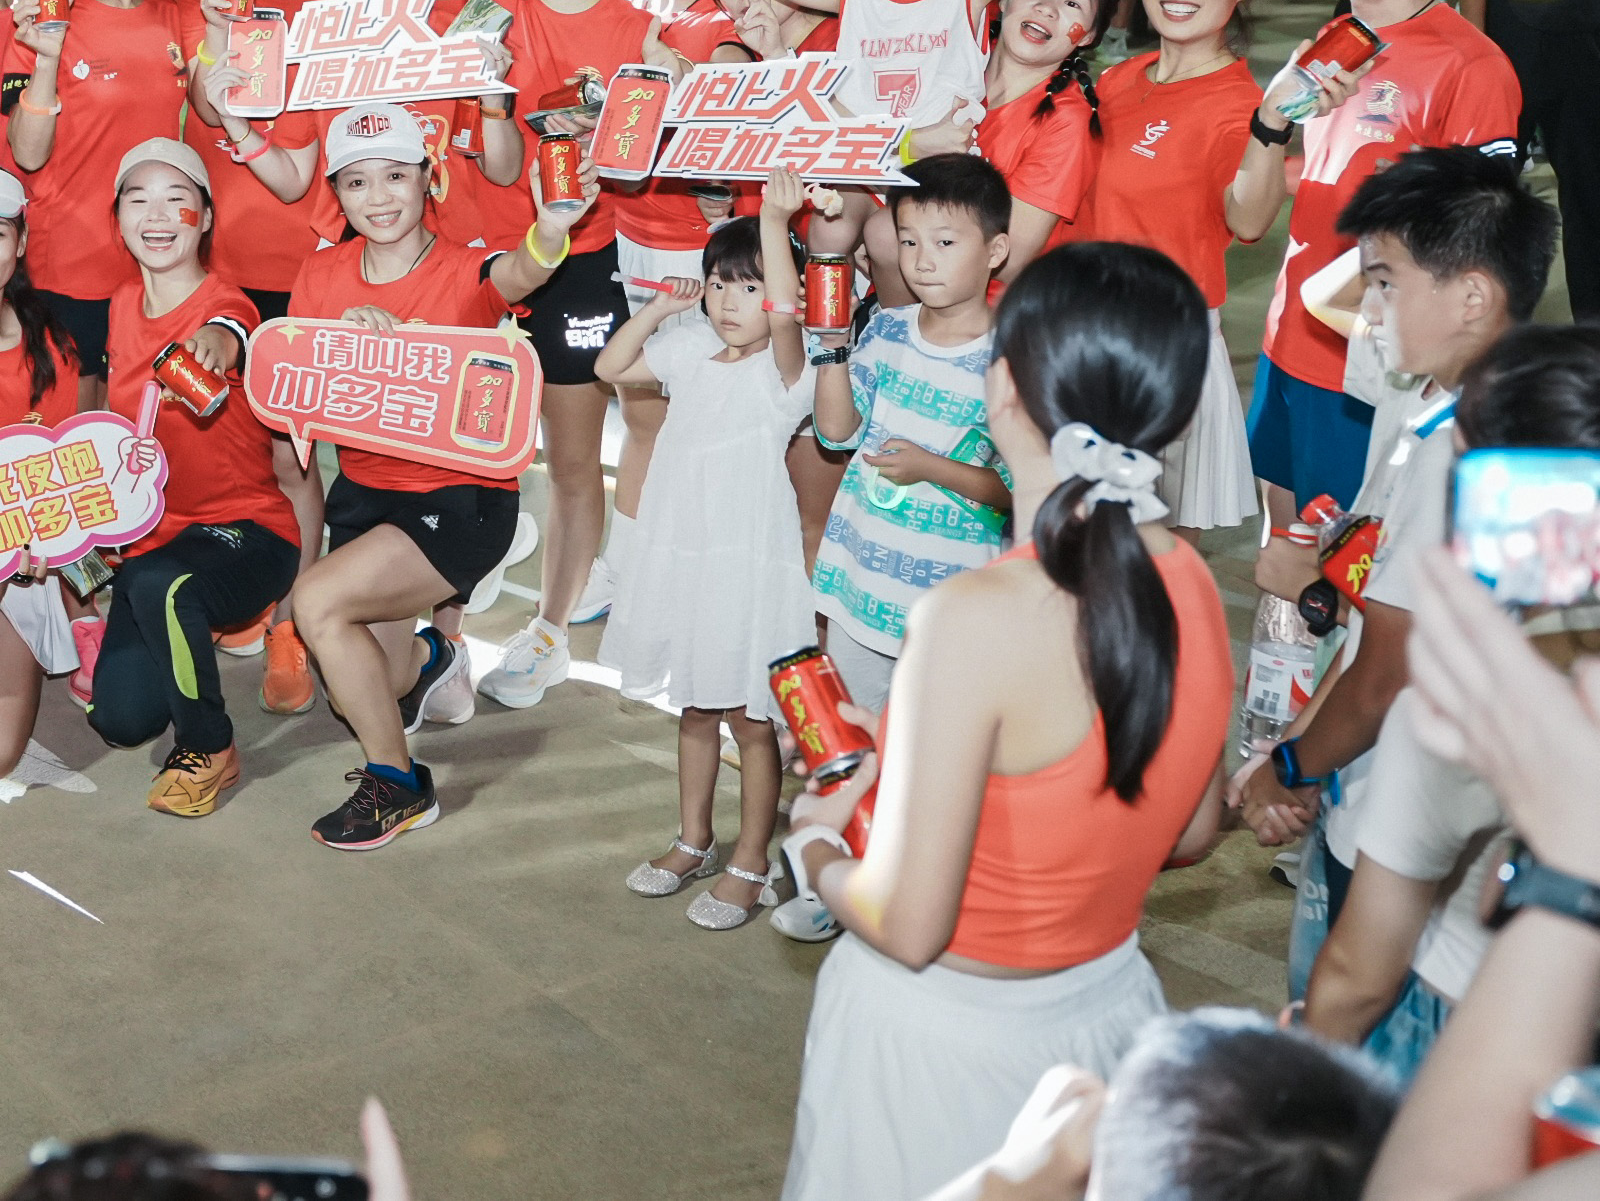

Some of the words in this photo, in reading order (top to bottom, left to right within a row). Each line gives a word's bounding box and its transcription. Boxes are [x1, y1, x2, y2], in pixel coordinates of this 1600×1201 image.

[297, 39, 488, 102] 喝加多宝
[677, 61, 840, 123] 怕上火
[669, 126, 899, 177] 喝加多宝
[312, 328, 452, 385] 请叫我
[267, 362, 439, 438] 加多宝
